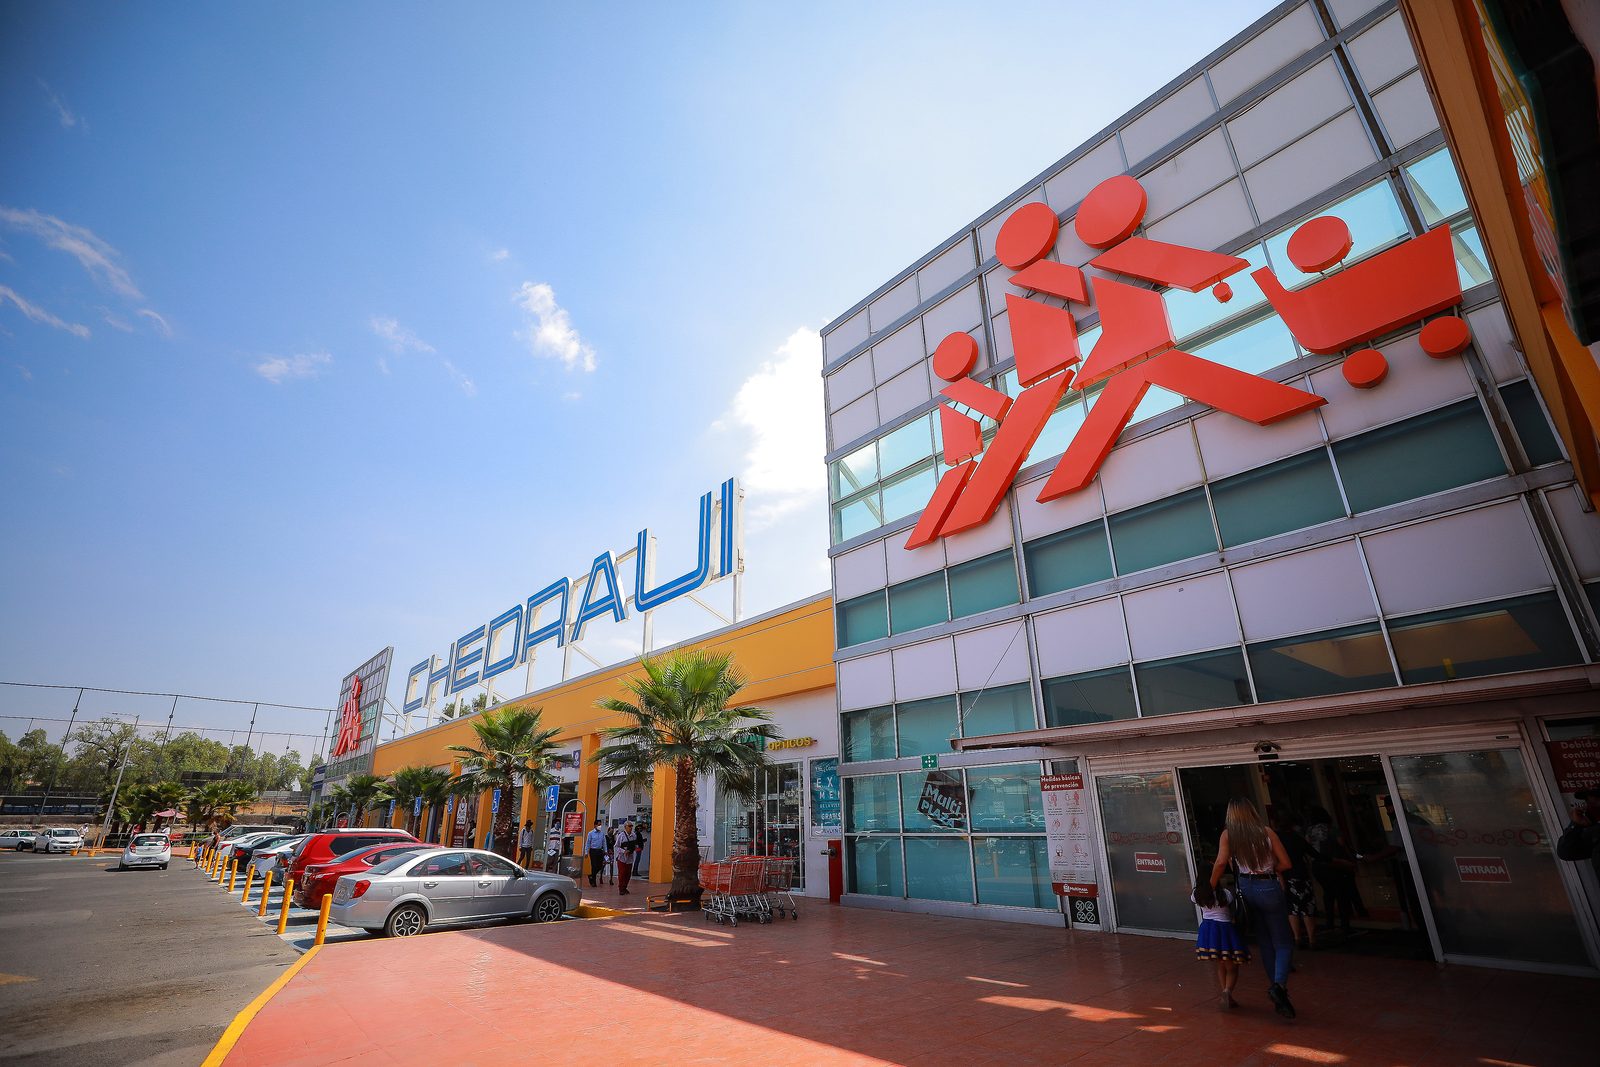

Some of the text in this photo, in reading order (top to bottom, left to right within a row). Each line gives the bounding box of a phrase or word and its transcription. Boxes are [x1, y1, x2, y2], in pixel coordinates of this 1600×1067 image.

[403, 477, 738, 715] CHEDRAUI
[1560, 740, 1598, 749] Debido
[1573, 760, 1596, 768] fase
[924, 784, 962, 816] Multi
[1460, 865, 1505, 874] ENTRADA
